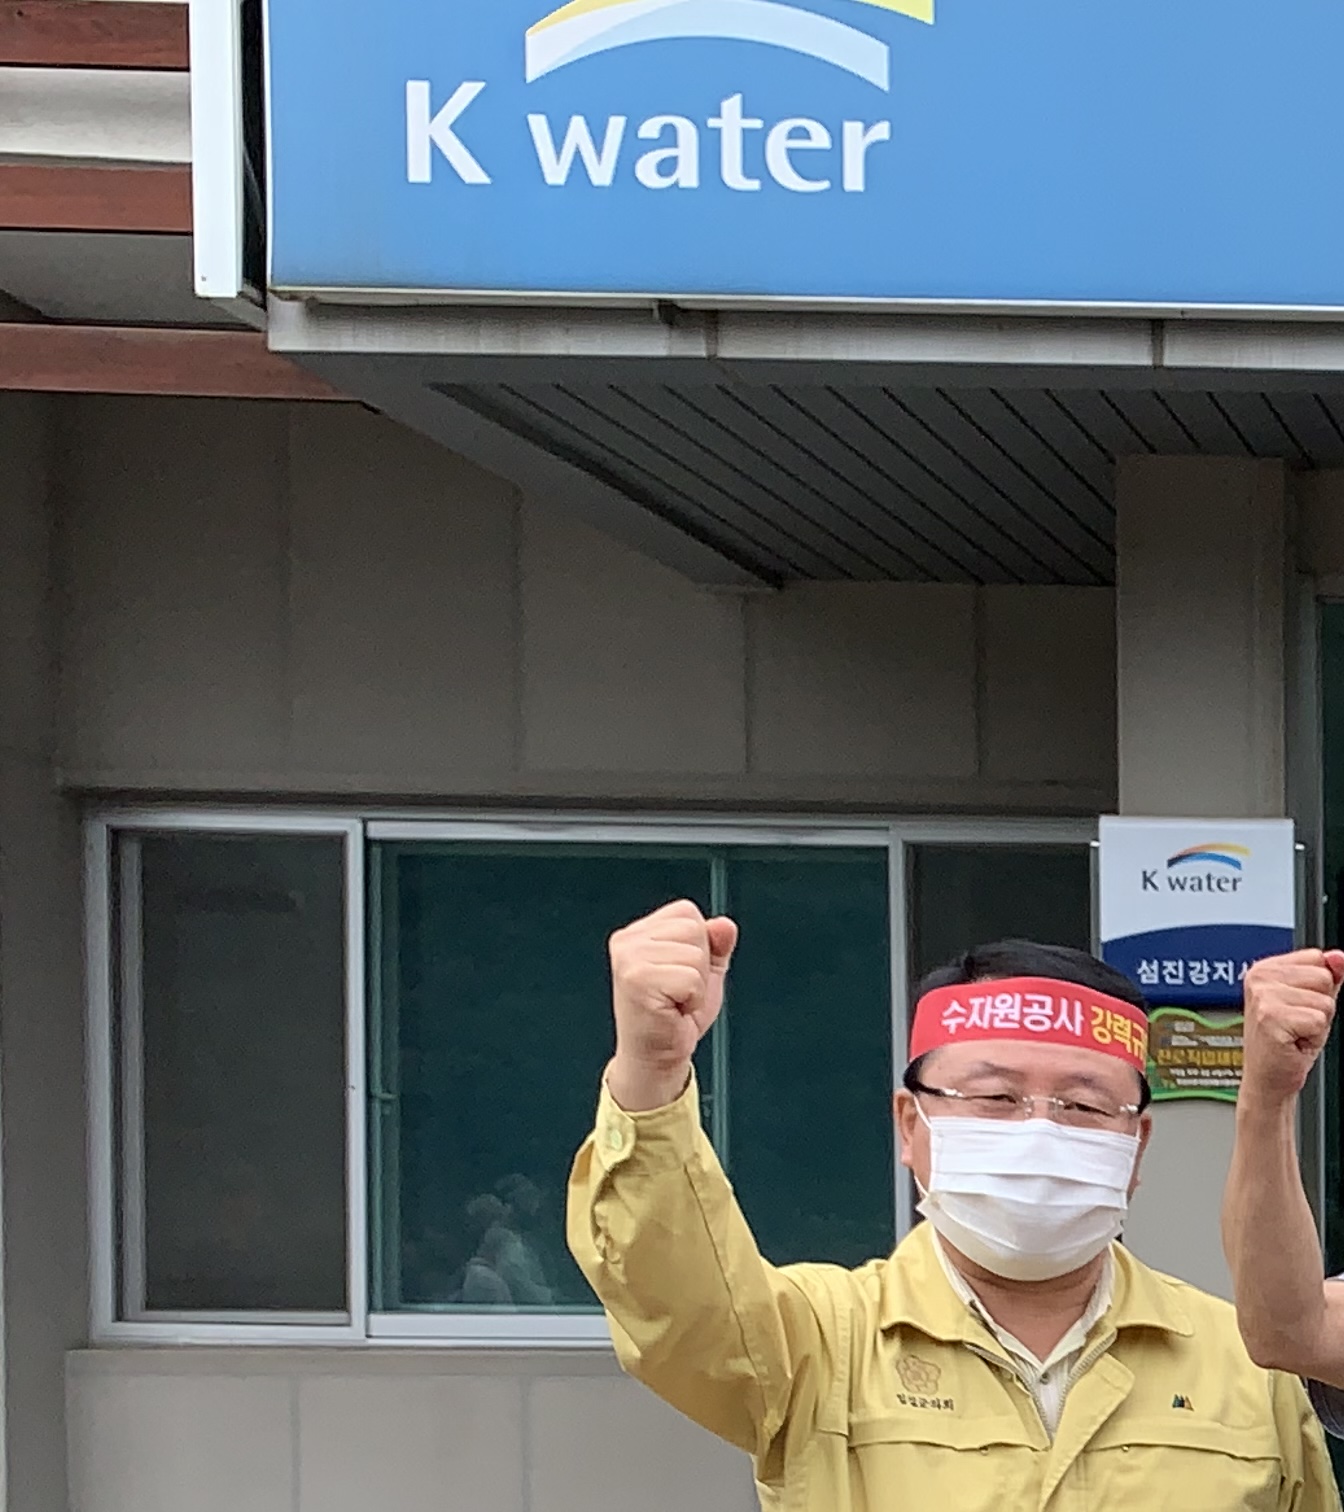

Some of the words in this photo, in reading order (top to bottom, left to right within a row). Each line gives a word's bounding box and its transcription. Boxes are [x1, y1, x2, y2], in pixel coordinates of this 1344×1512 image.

[407, 80, 490, 184] K
[527, 92, 891, 192] water
[1143, 871, 1158, 890] K
[1168, 873, 1242, 893] water
[941, 992, 1084, 1036] 수자원공사
